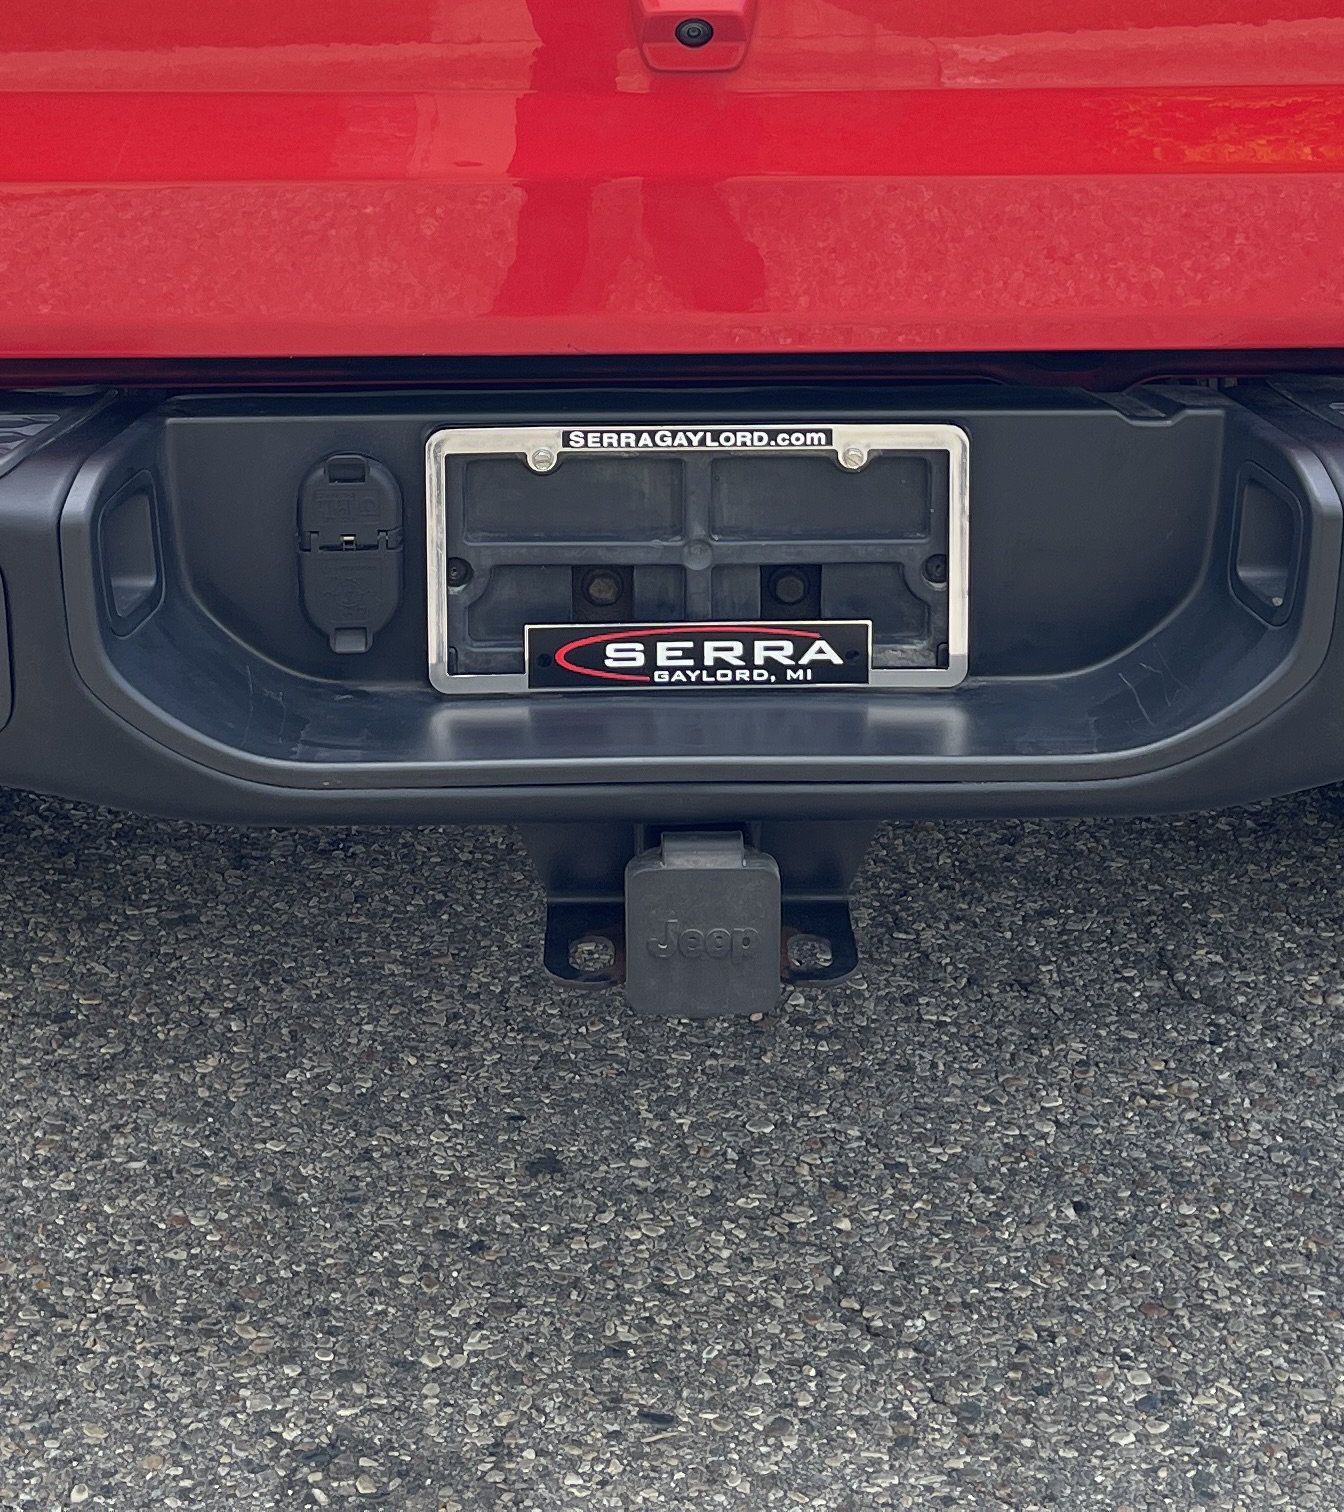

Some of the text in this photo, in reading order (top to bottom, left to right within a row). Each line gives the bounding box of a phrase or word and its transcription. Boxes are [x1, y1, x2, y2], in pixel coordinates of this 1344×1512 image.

[568, 430, 827, 449] SERRAGAYLORD.com
[604, 640, 844, 668] SERRA
[653, 668, 813, 684] GAYLORD, MI
[647, 919, 758, 965] Jeep
